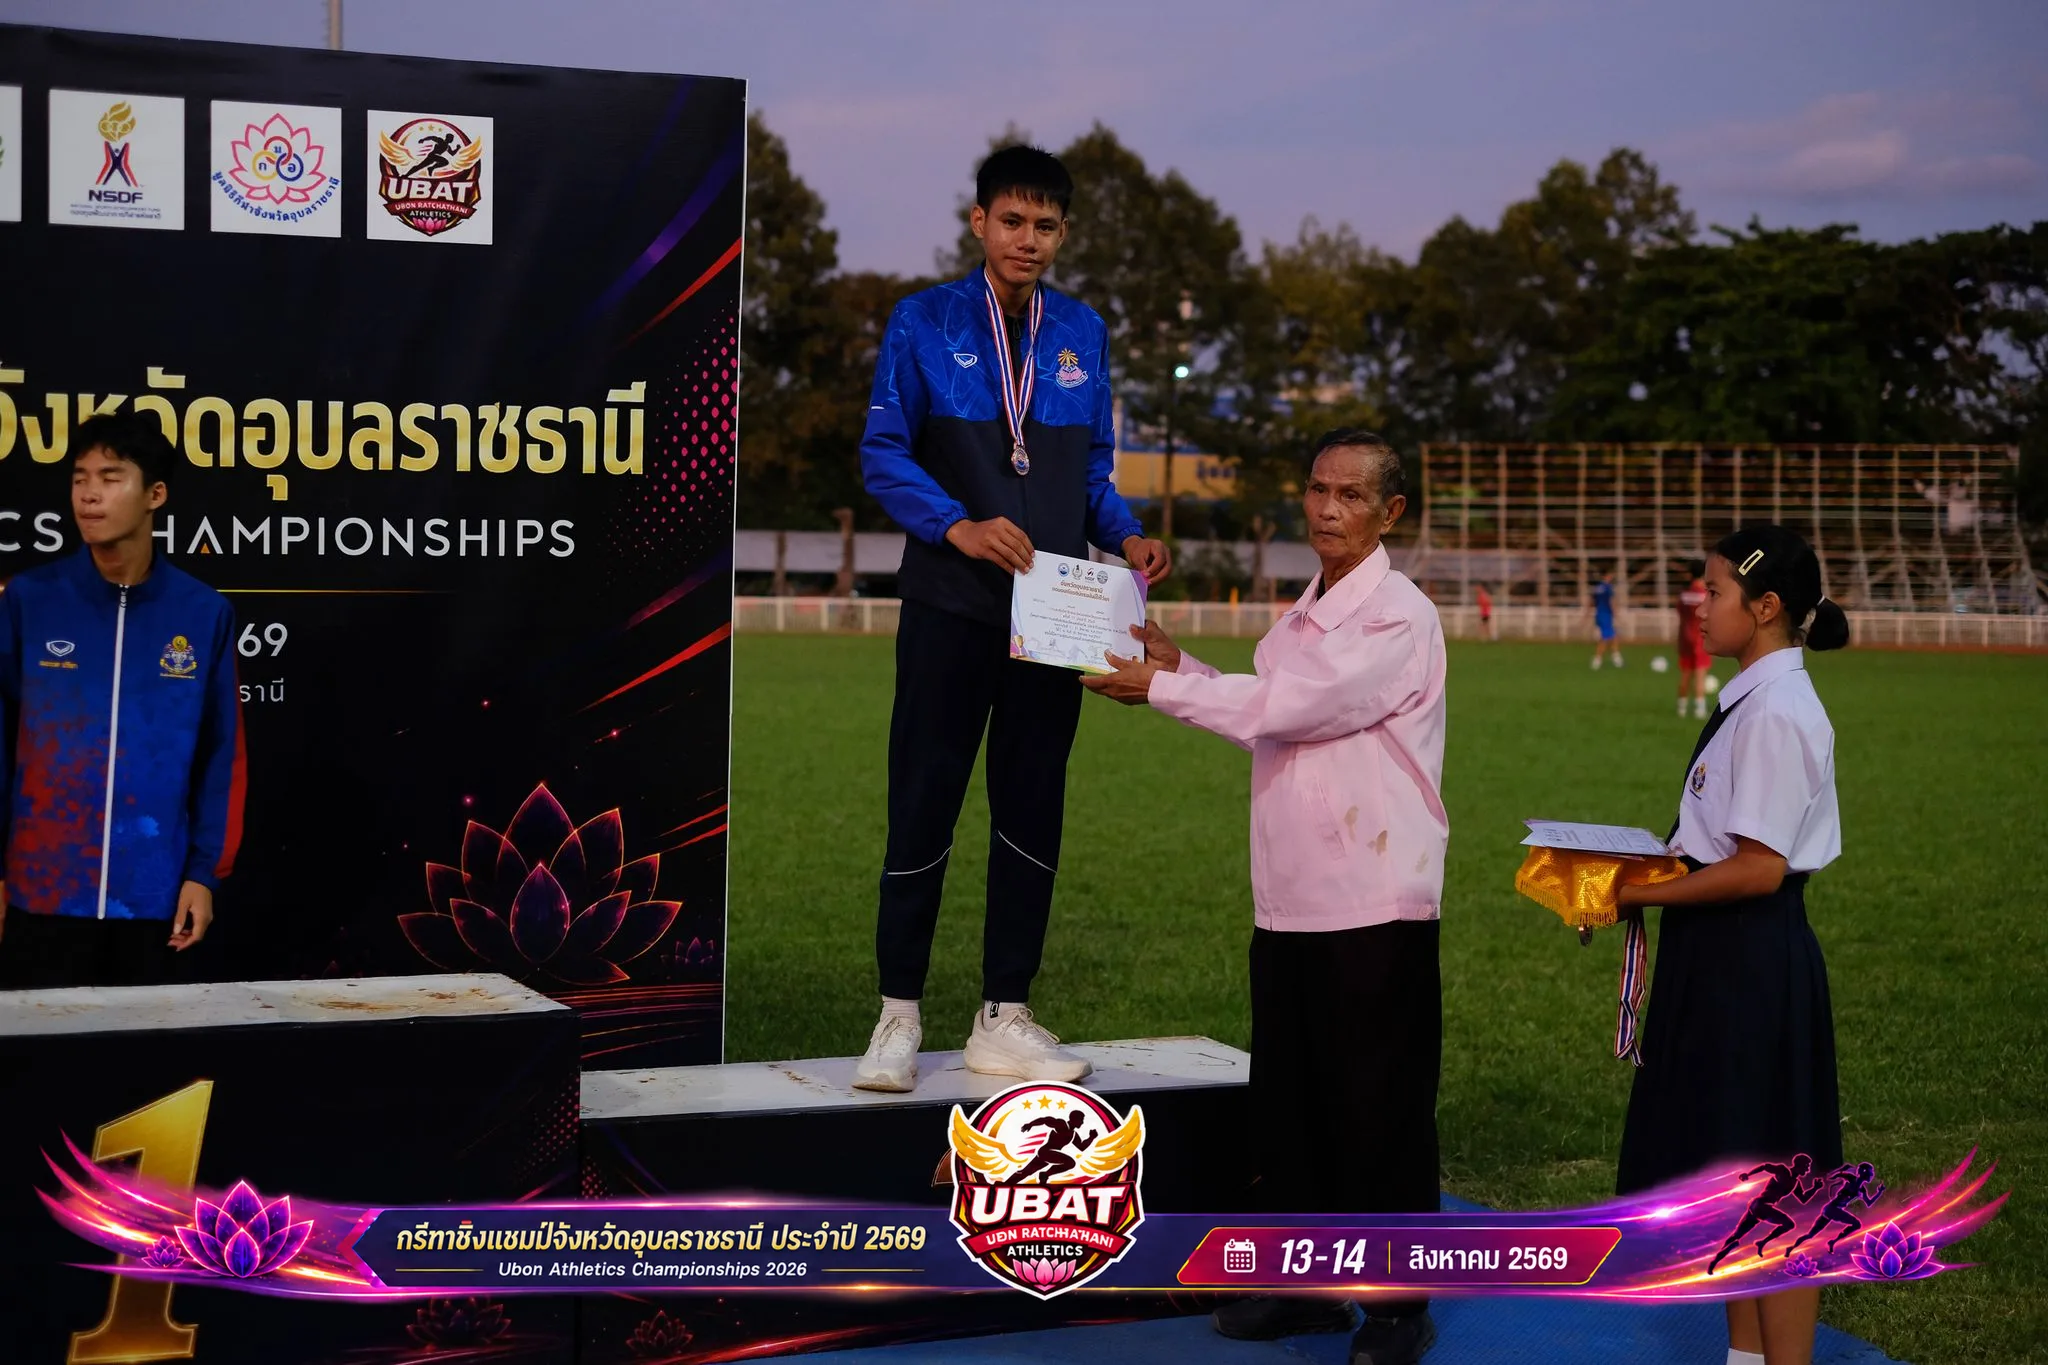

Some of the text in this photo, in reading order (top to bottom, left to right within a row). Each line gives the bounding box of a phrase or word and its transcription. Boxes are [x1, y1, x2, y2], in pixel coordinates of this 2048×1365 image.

[387, 177, 473, 203] UBAT
[88, 190, 143, 204] NSDF
[395, 202, 468, 214] UBON RATCHATHANI
[410, 210, 451, 218] ATHLETICS
